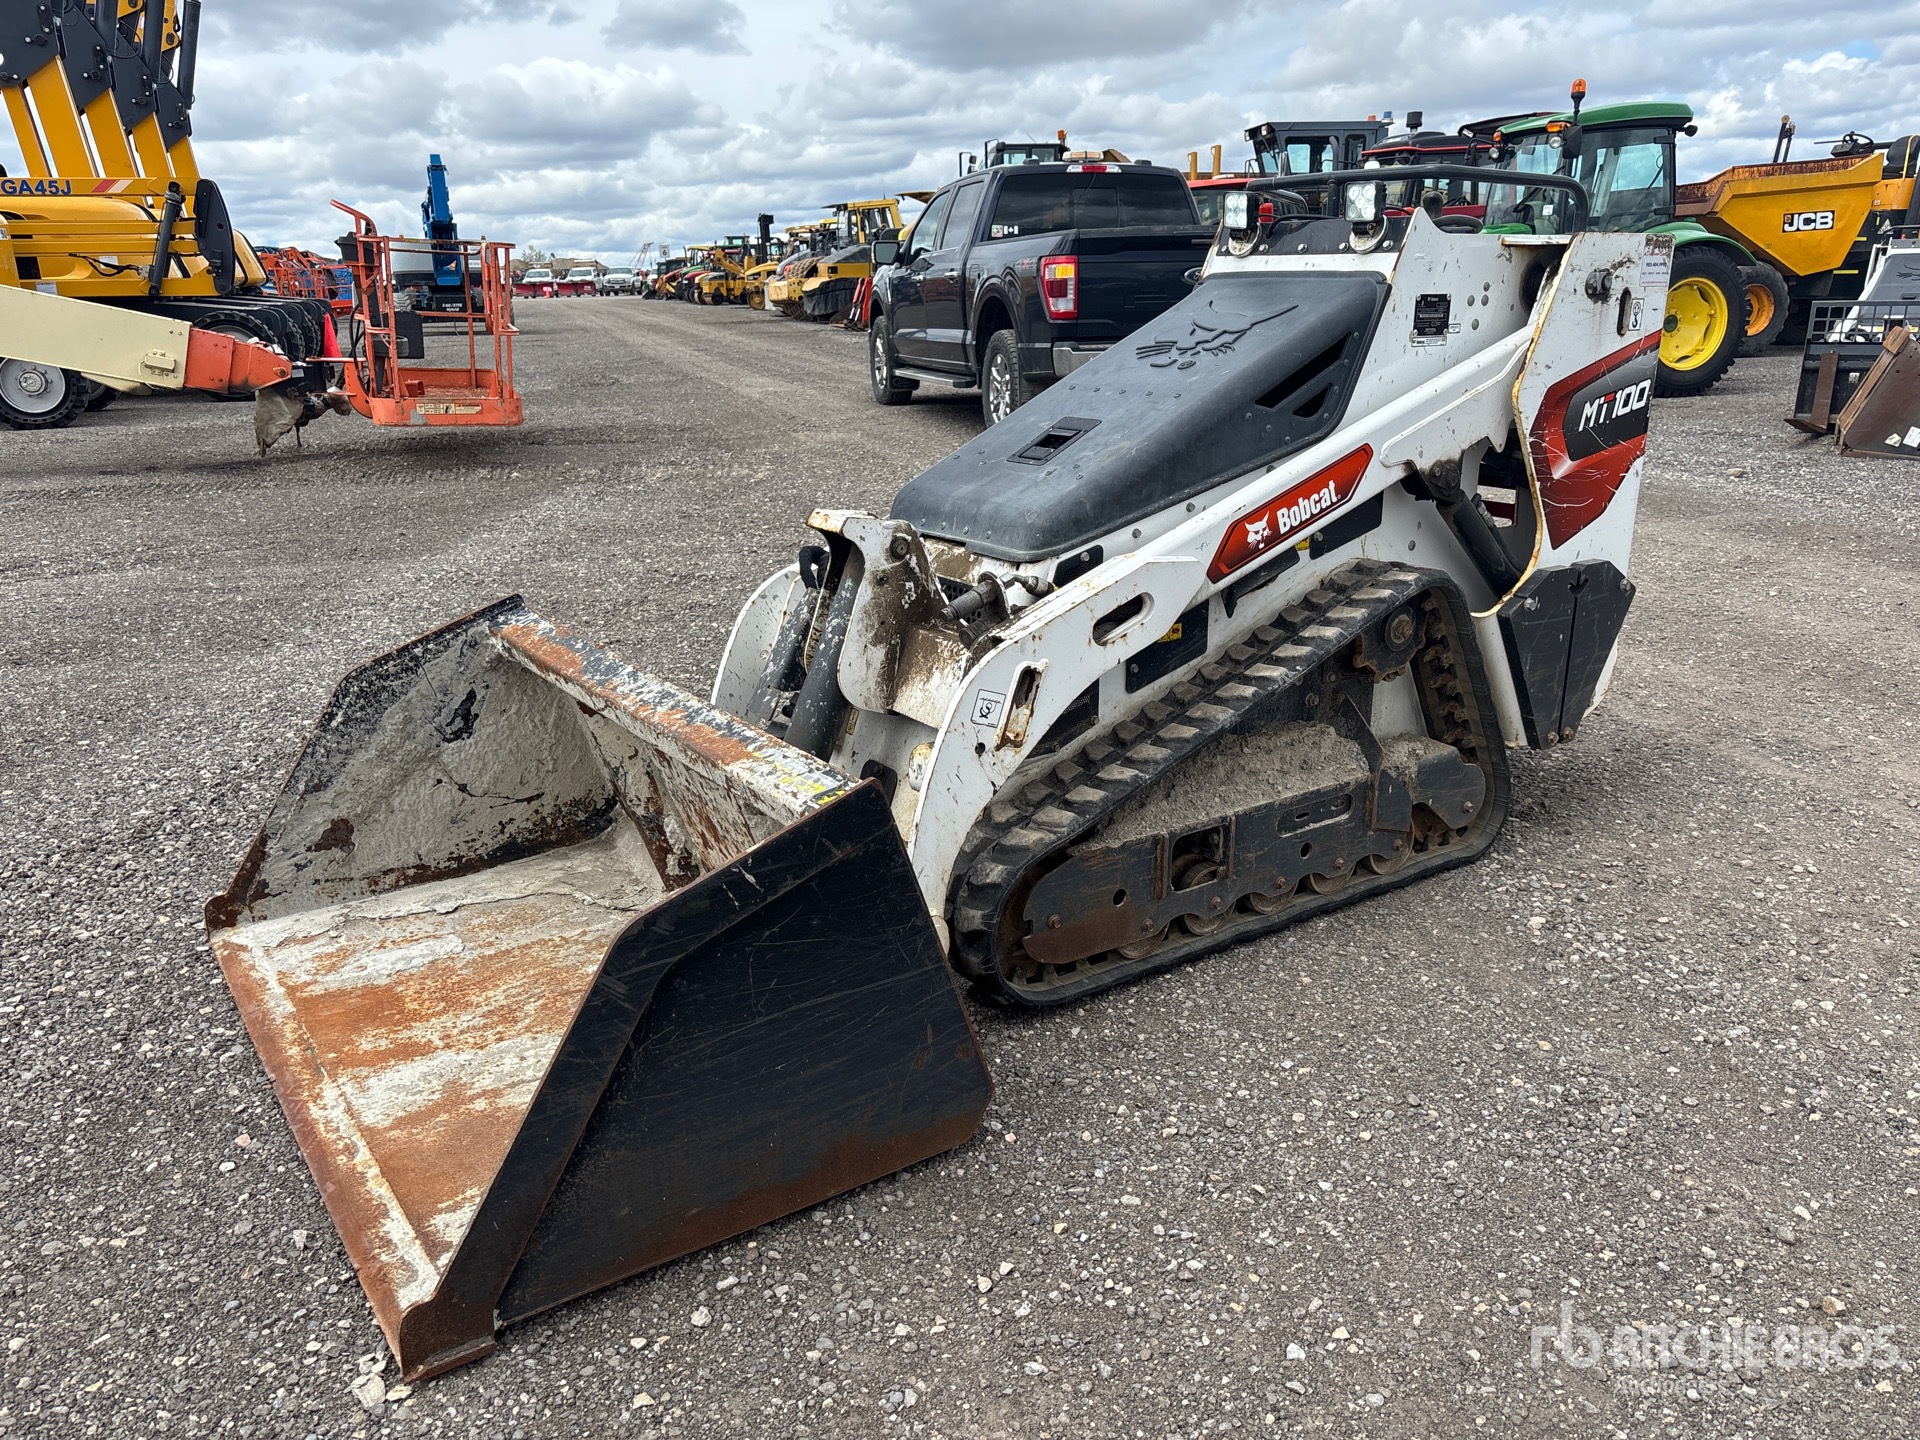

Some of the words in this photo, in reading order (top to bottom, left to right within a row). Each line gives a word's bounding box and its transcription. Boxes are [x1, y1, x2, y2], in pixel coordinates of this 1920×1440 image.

[1, 179, 71, 195] GA45J
[1784, 212, 1833, 231] JCB
[1579, 379, 1651, 432] MT100
[1277, 479, 1338, 535] Bobcat
